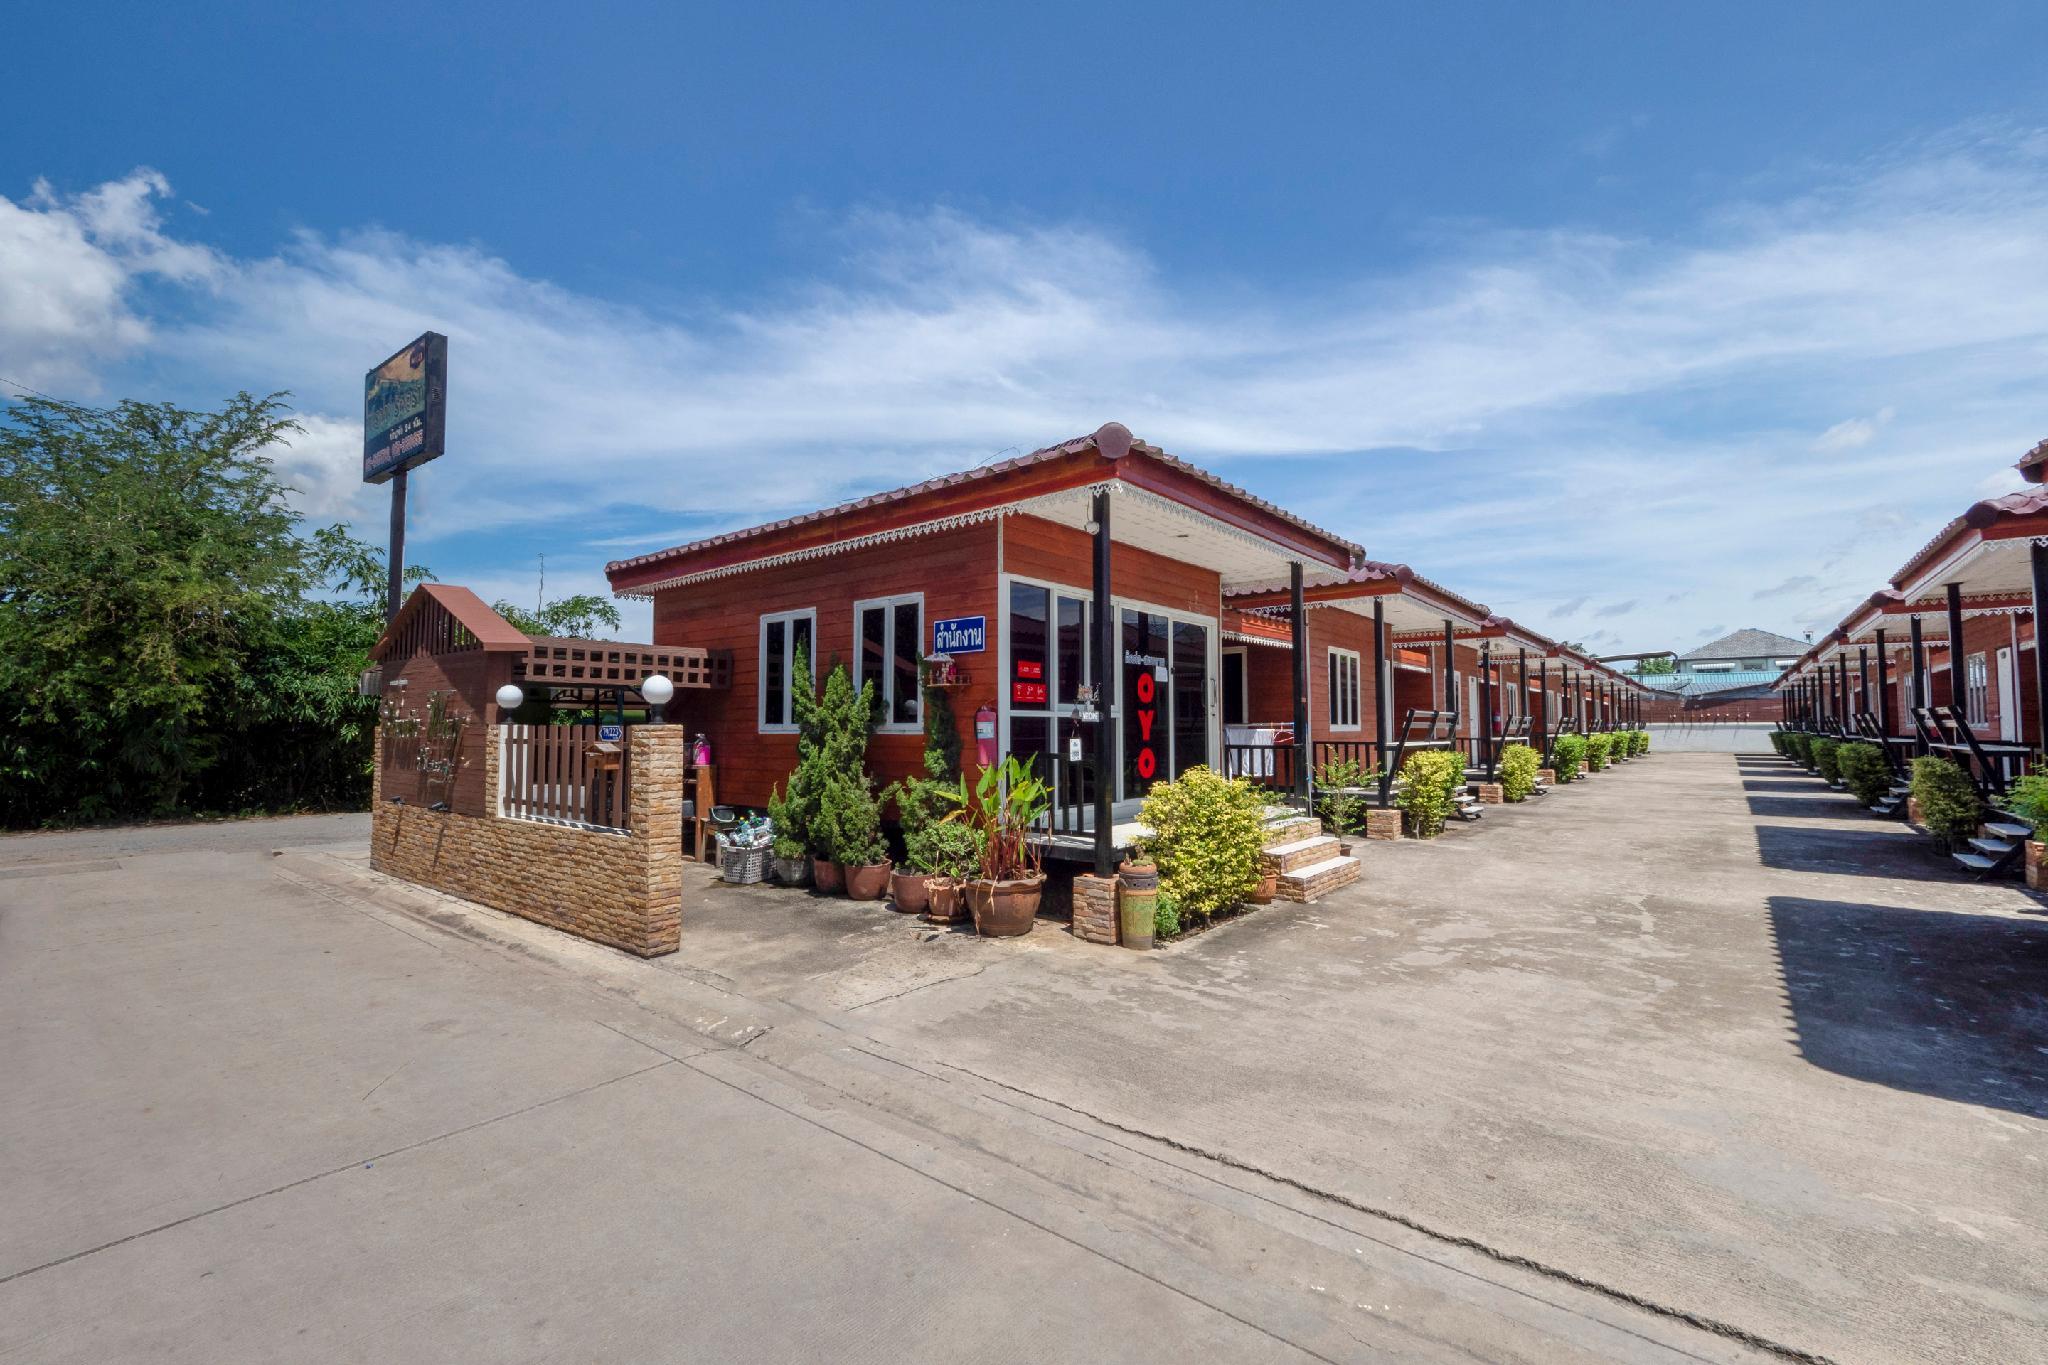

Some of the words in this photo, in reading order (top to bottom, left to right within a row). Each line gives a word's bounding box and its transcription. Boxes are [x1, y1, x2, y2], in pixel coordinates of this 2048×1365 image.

[936, 623, 982, 649] สำนักงาน
[1137, 672, 1155, 779] OYO
